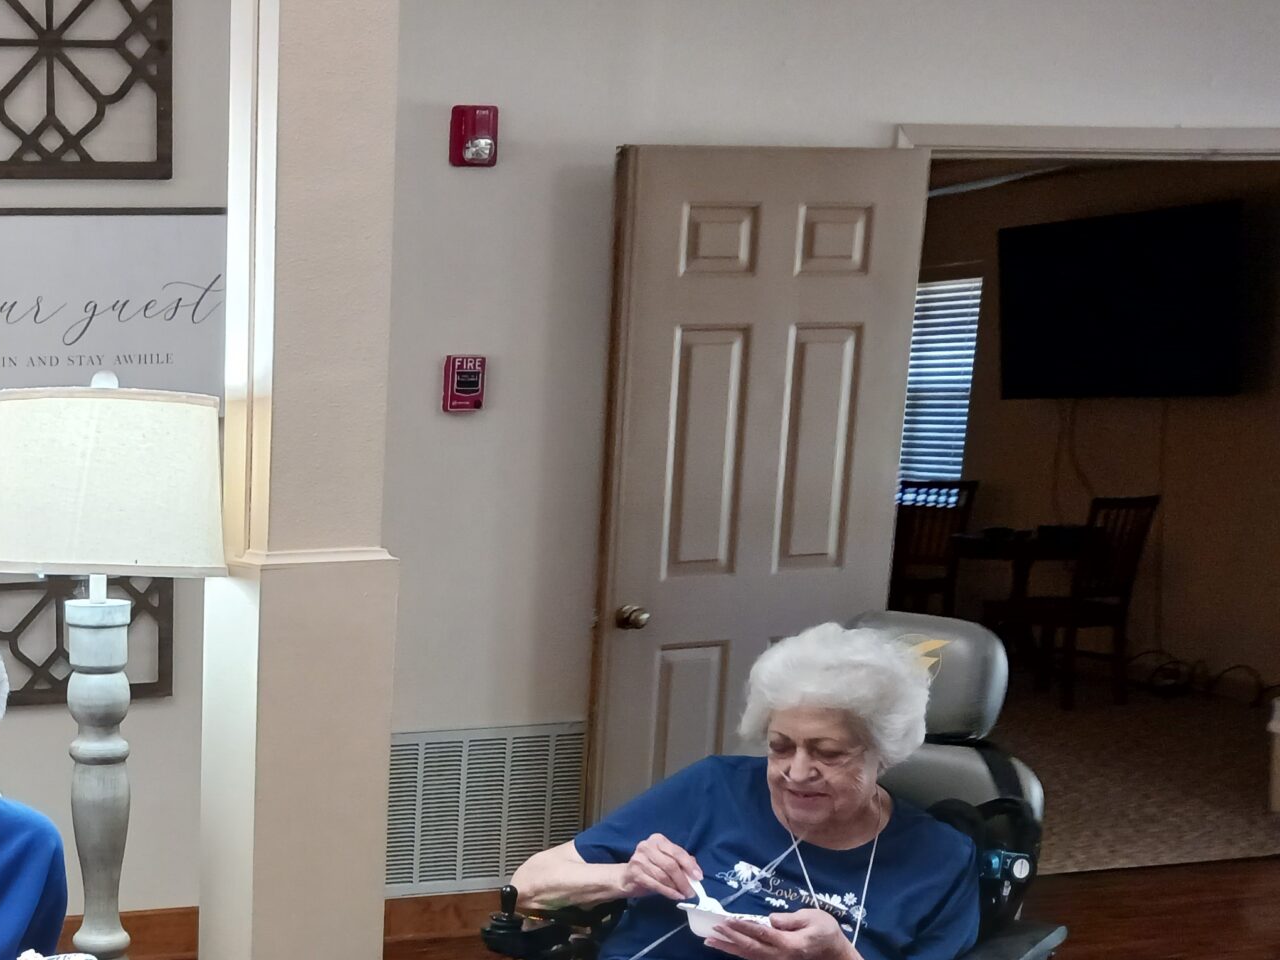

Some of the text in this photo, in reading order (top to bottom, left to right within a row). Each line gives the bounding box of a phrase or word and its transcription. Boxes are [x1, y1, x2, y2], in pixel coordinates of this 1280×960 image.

[62, 273, 225, 346] guest
[1, 355, 18, 368] IN
[26, 355, 60, 367] AND
[66, 354, 105, 367] STAY
[113, 352, 174, 366] AWHILE
[455, 358, 482, 370] FIRE
[762, 876, 801, 901] Love
